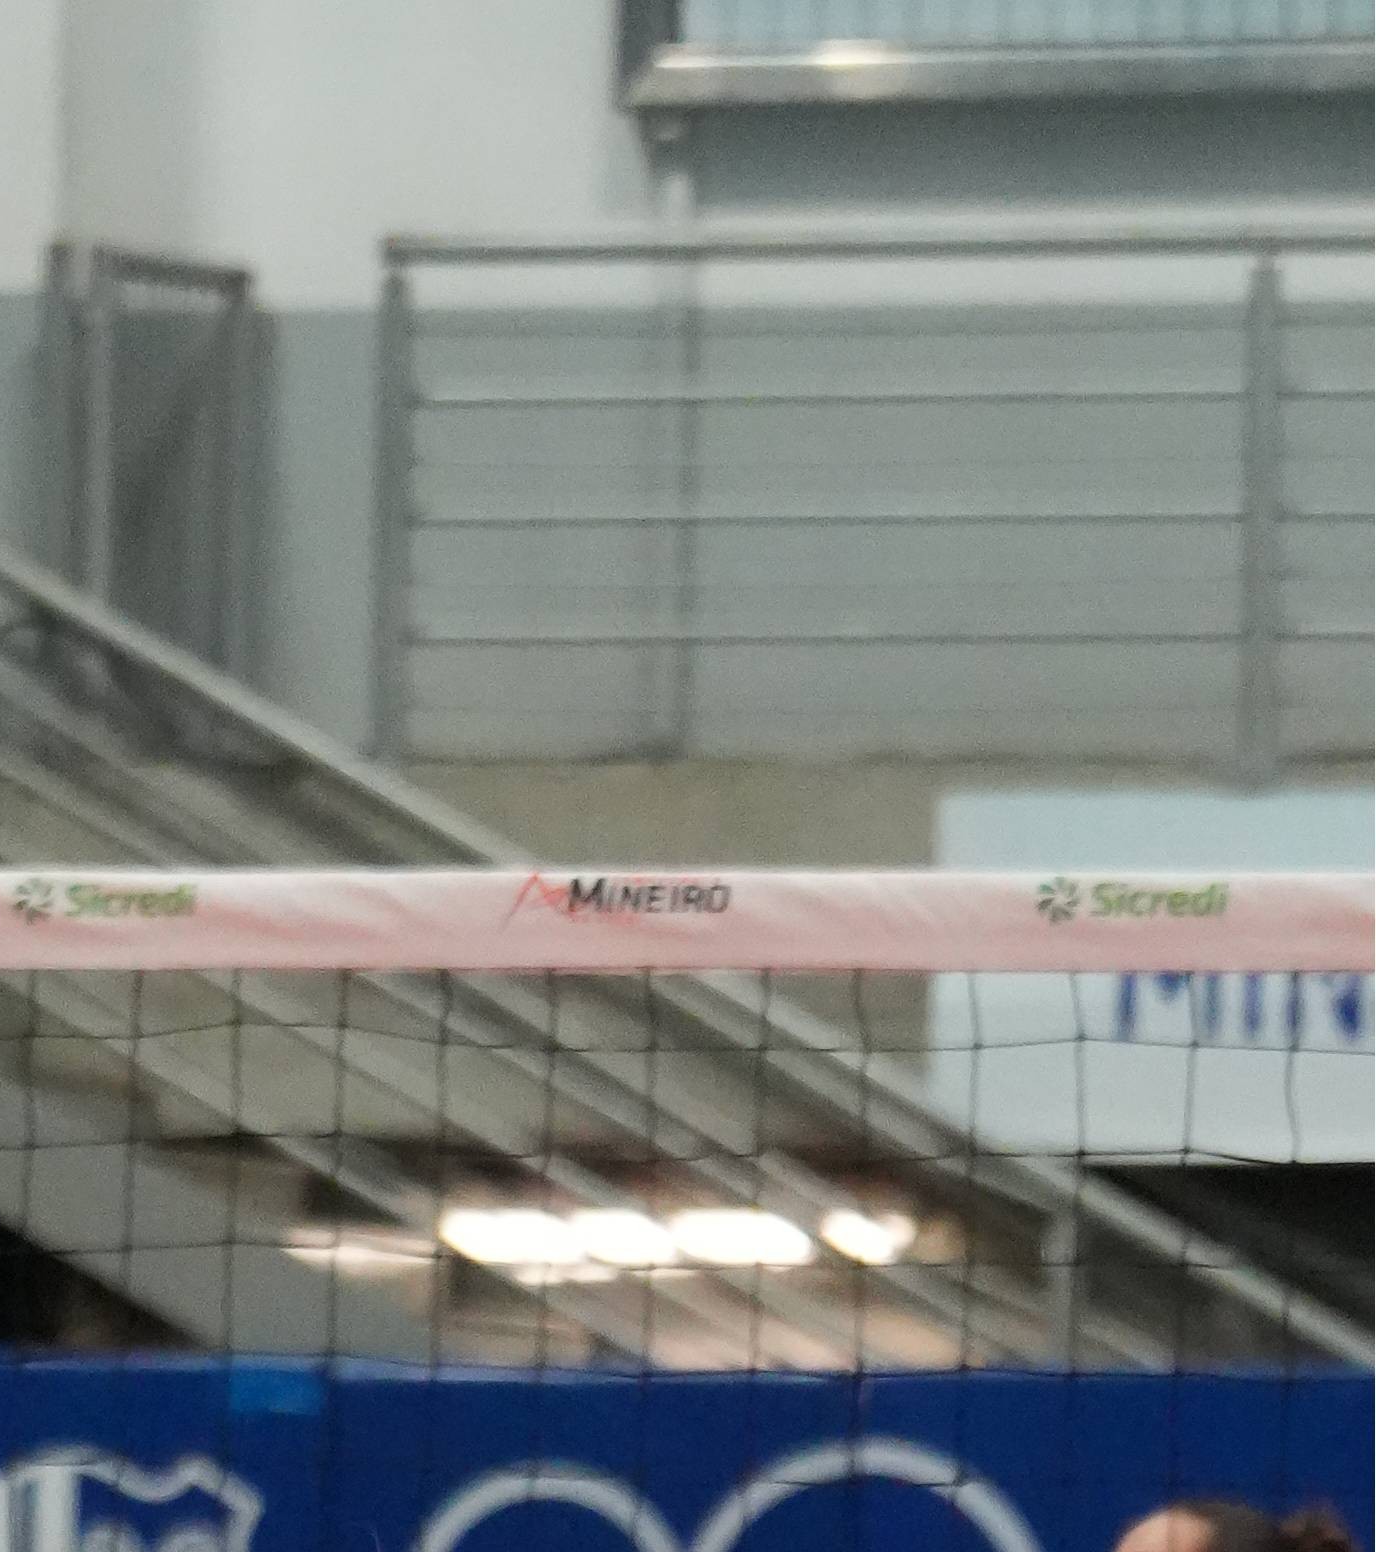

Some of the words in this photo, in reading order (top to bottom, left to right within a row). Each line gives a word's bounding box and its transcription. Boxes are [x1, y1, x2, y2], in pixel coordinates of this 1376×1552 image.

[65, 883, 197, 917] Sicredi
[567, 878, 732, 914] MINEIRO
[1091, 881, 1229, 917] Sicredi
